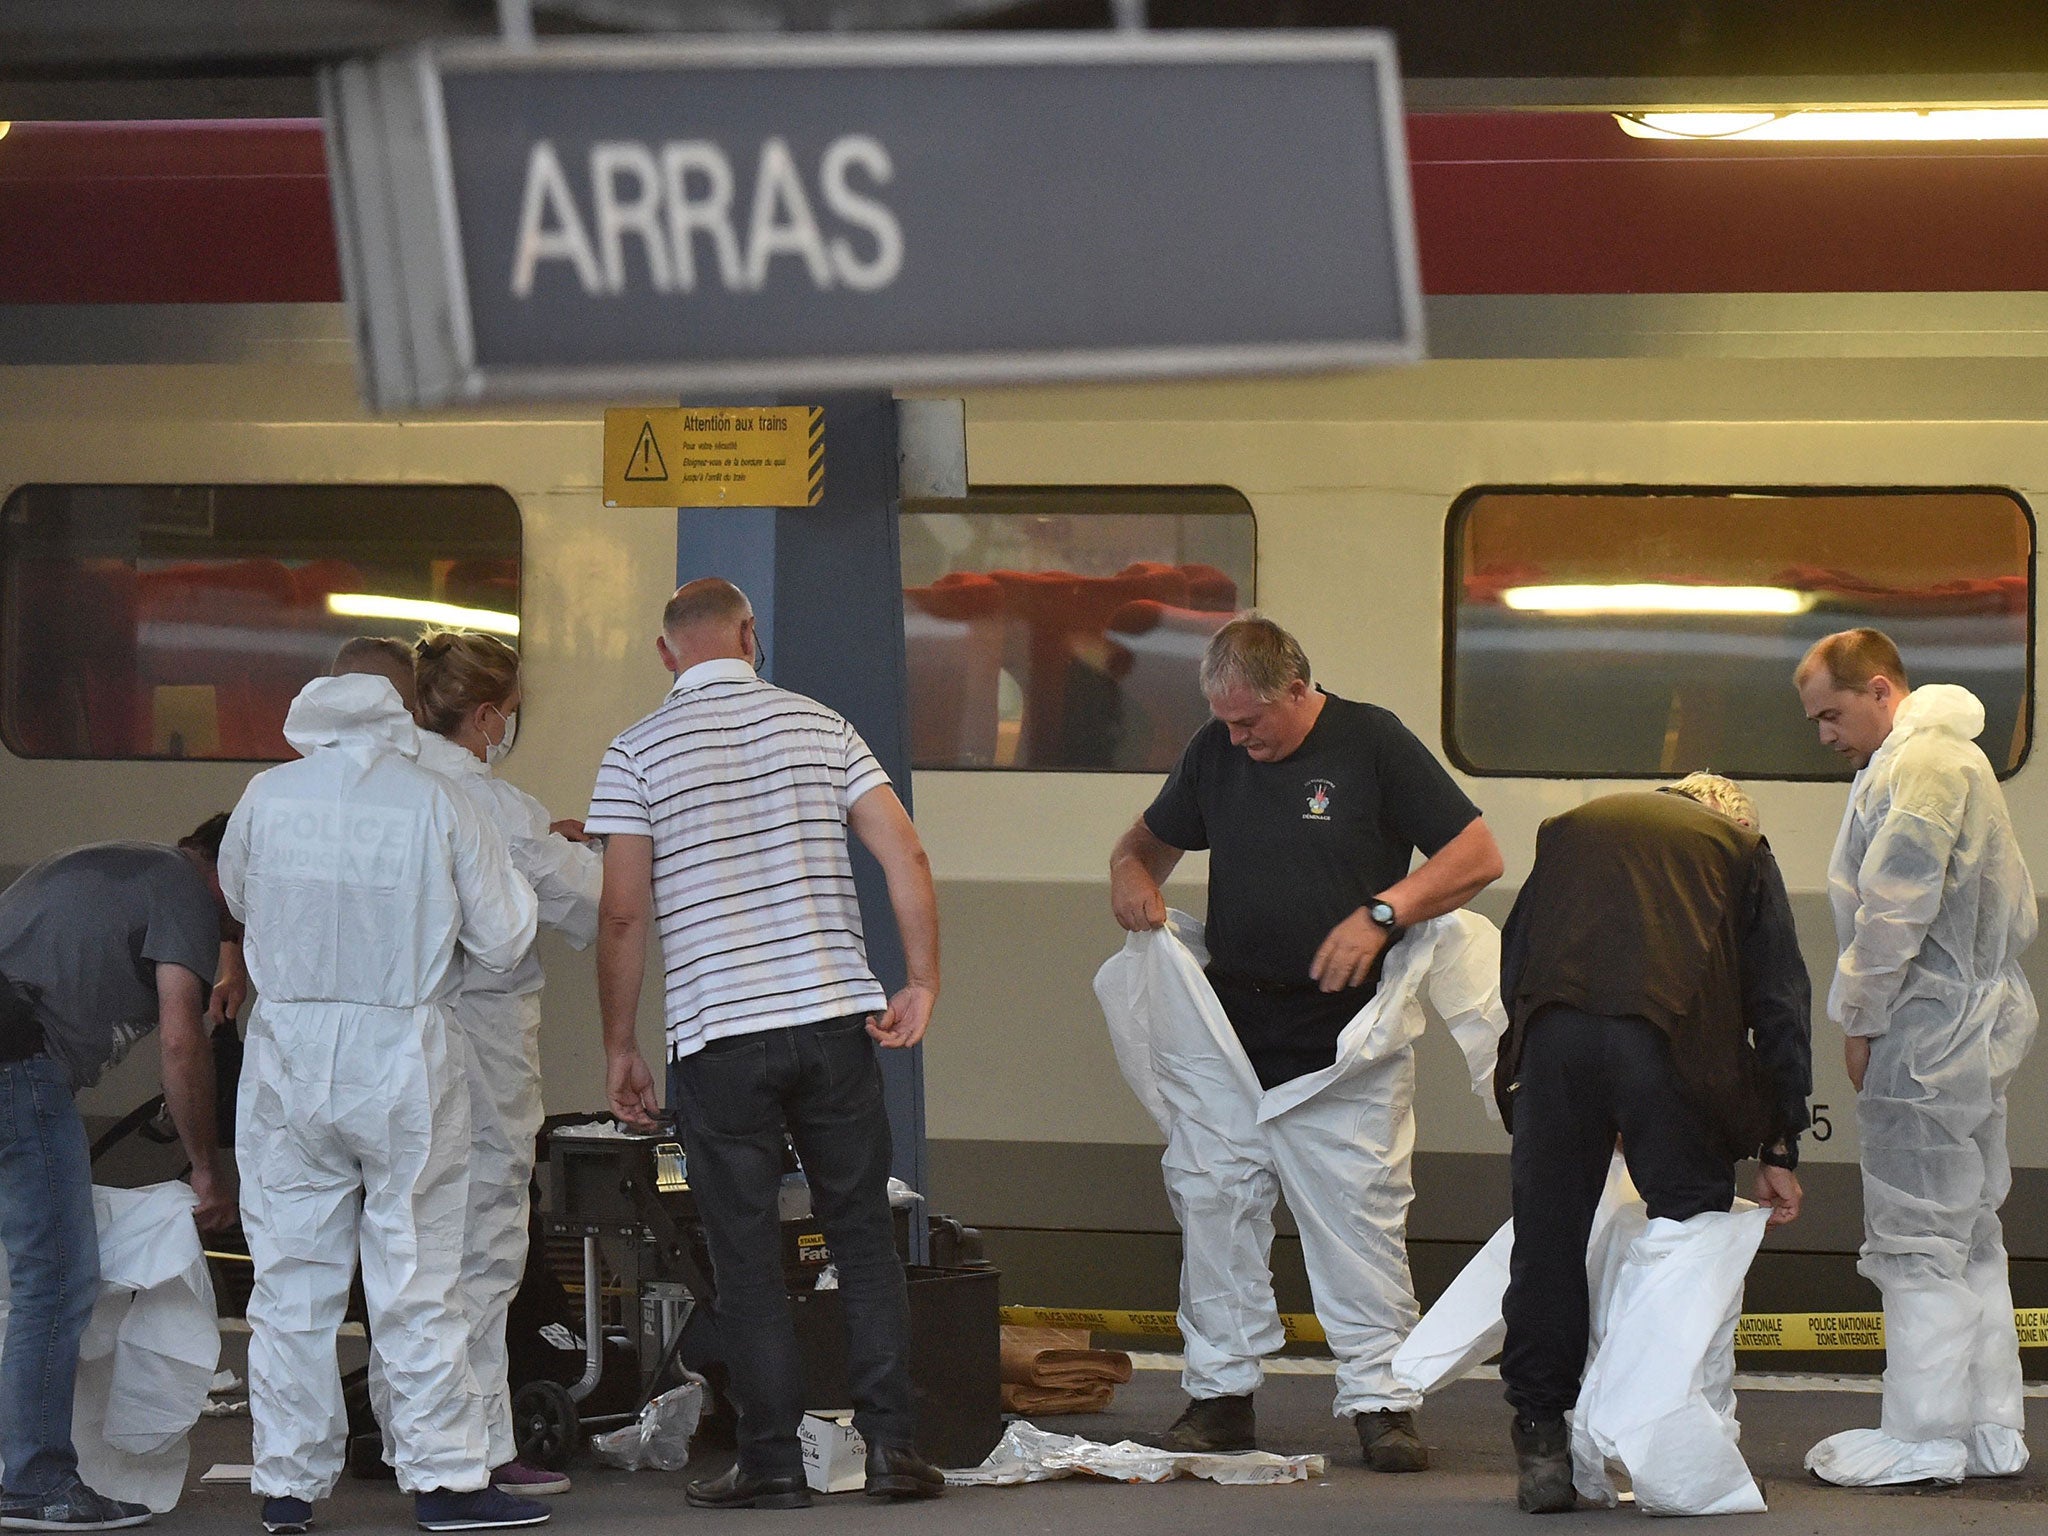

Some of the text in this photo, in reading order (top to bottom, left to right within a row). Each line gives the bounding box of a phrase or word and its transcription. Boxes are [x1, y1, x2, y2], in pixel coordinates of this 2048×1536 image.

[511, 134, 904, 296] ARRAS
[684, 415, 787, 431] Attention aux trains
[683, 441, 695, 450] Pour
[724, 458, 731, 466] de
[764, 457, 772, 466] du
[723, 473, 731, 481] du
[269, 810, 408, 850] POLICE
[799, 1246, 830, 1262] Fat
[643, 1299, 655, 1336] PEL
[1128, 1314, 1158, 1325] POLICE
[1809, 1317, 1881, 1331] POLICE NATIONALE
[2014, 1312, 2038, 1327] OLICE
[1740, 1319, 1782, 1331] NATIONALE
[1742, 1333, 1782, 1346] INTERDITE
[1816, 1332, 1880, 1346] ZONE INTERDITE
